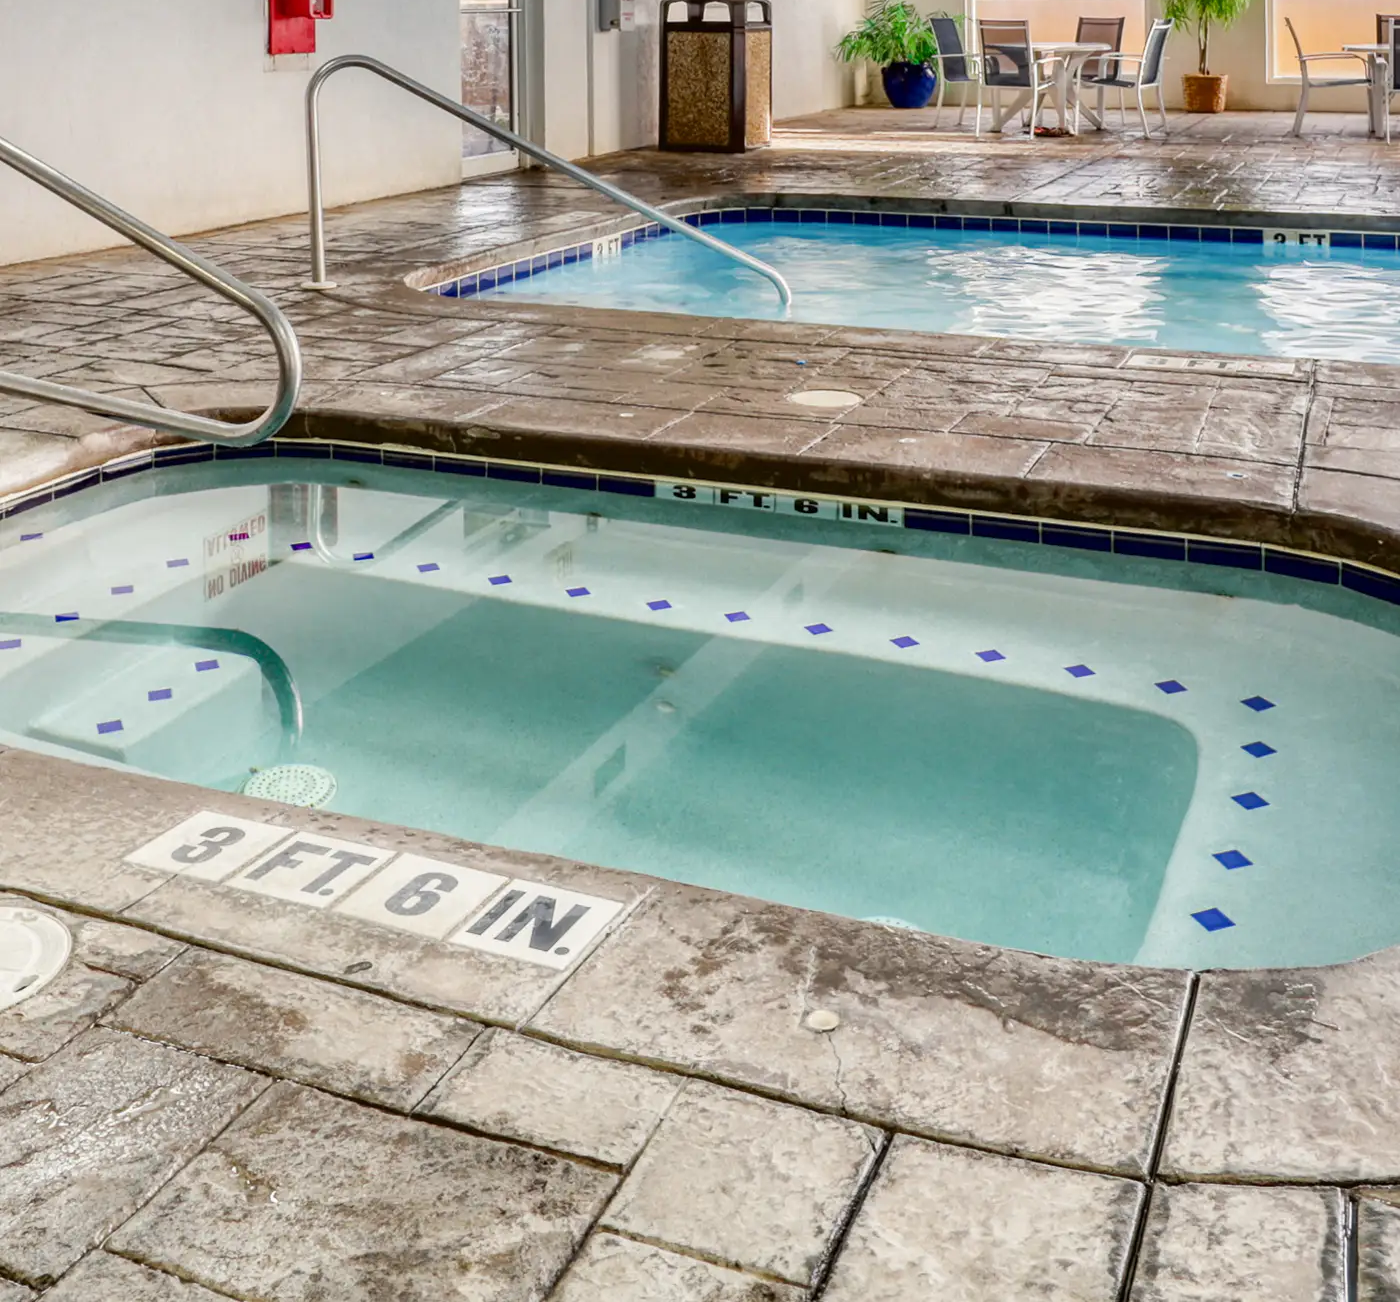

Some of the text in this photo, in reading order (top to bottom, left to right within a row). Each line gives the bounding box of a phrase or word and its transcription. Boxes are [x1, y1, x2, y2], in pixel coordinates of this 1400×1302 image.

[672, 484, 899, 524] 3 FT. 6 IN.
[170, 825, 592, 956] 3 FT. 6 IN.
